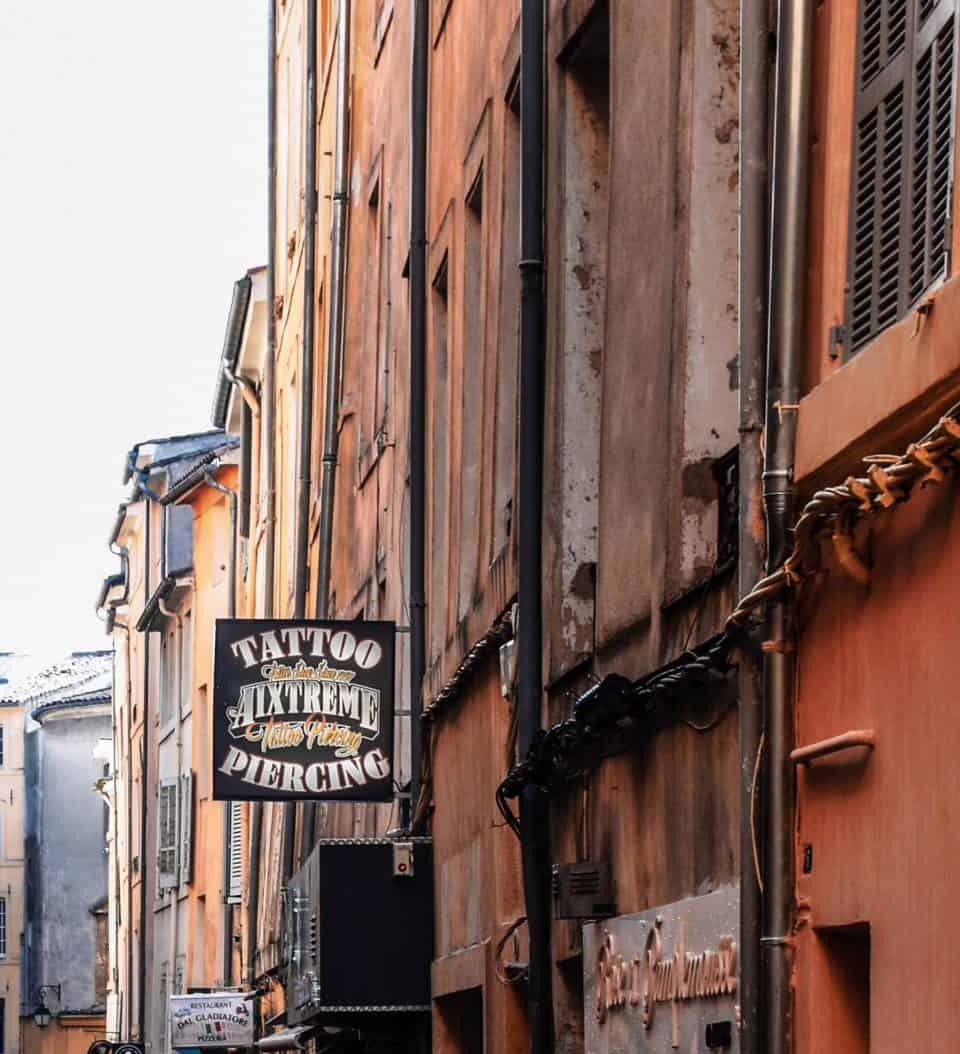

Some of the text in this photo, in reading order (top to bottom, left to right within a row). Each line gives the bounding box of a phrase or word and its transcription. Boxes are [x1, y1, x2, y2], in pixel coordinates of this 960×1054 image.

[231, 627, 382, 669] TATTOO
[228, 681, 379, 732] AIXTREME
[218, 746, 391, 792] PIERCING
